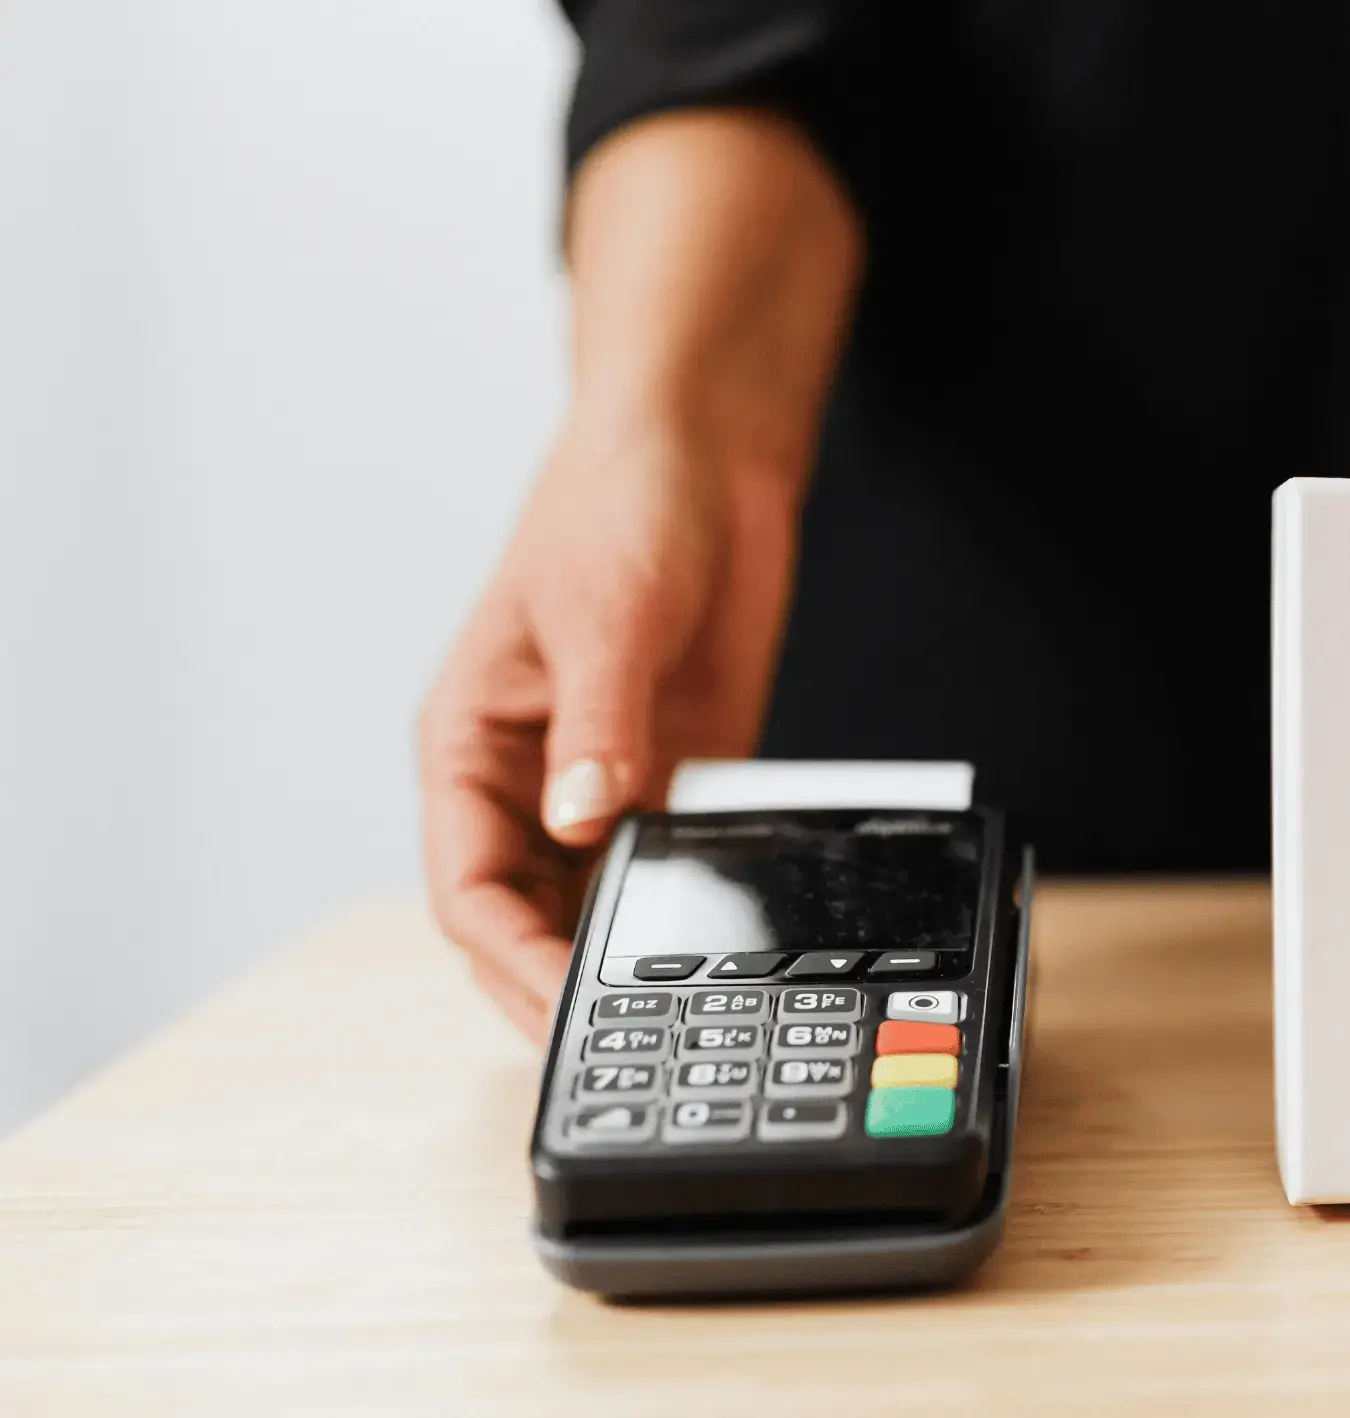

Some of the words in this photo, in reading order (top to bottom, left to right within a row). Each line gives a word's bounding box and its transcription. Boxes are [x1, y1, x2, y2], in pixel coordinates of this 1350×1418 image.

[612, 998, 630, 1014] 1
[702, 995, 728, 1012] 2
[793, 993, 818, 1010] 3
[598, 1031, 626, 1050] 4
[698, 1028, 724, 1048] 5
[786, 1026, 812, 1046] 6
[592, 1067, 619, 1091] 7
